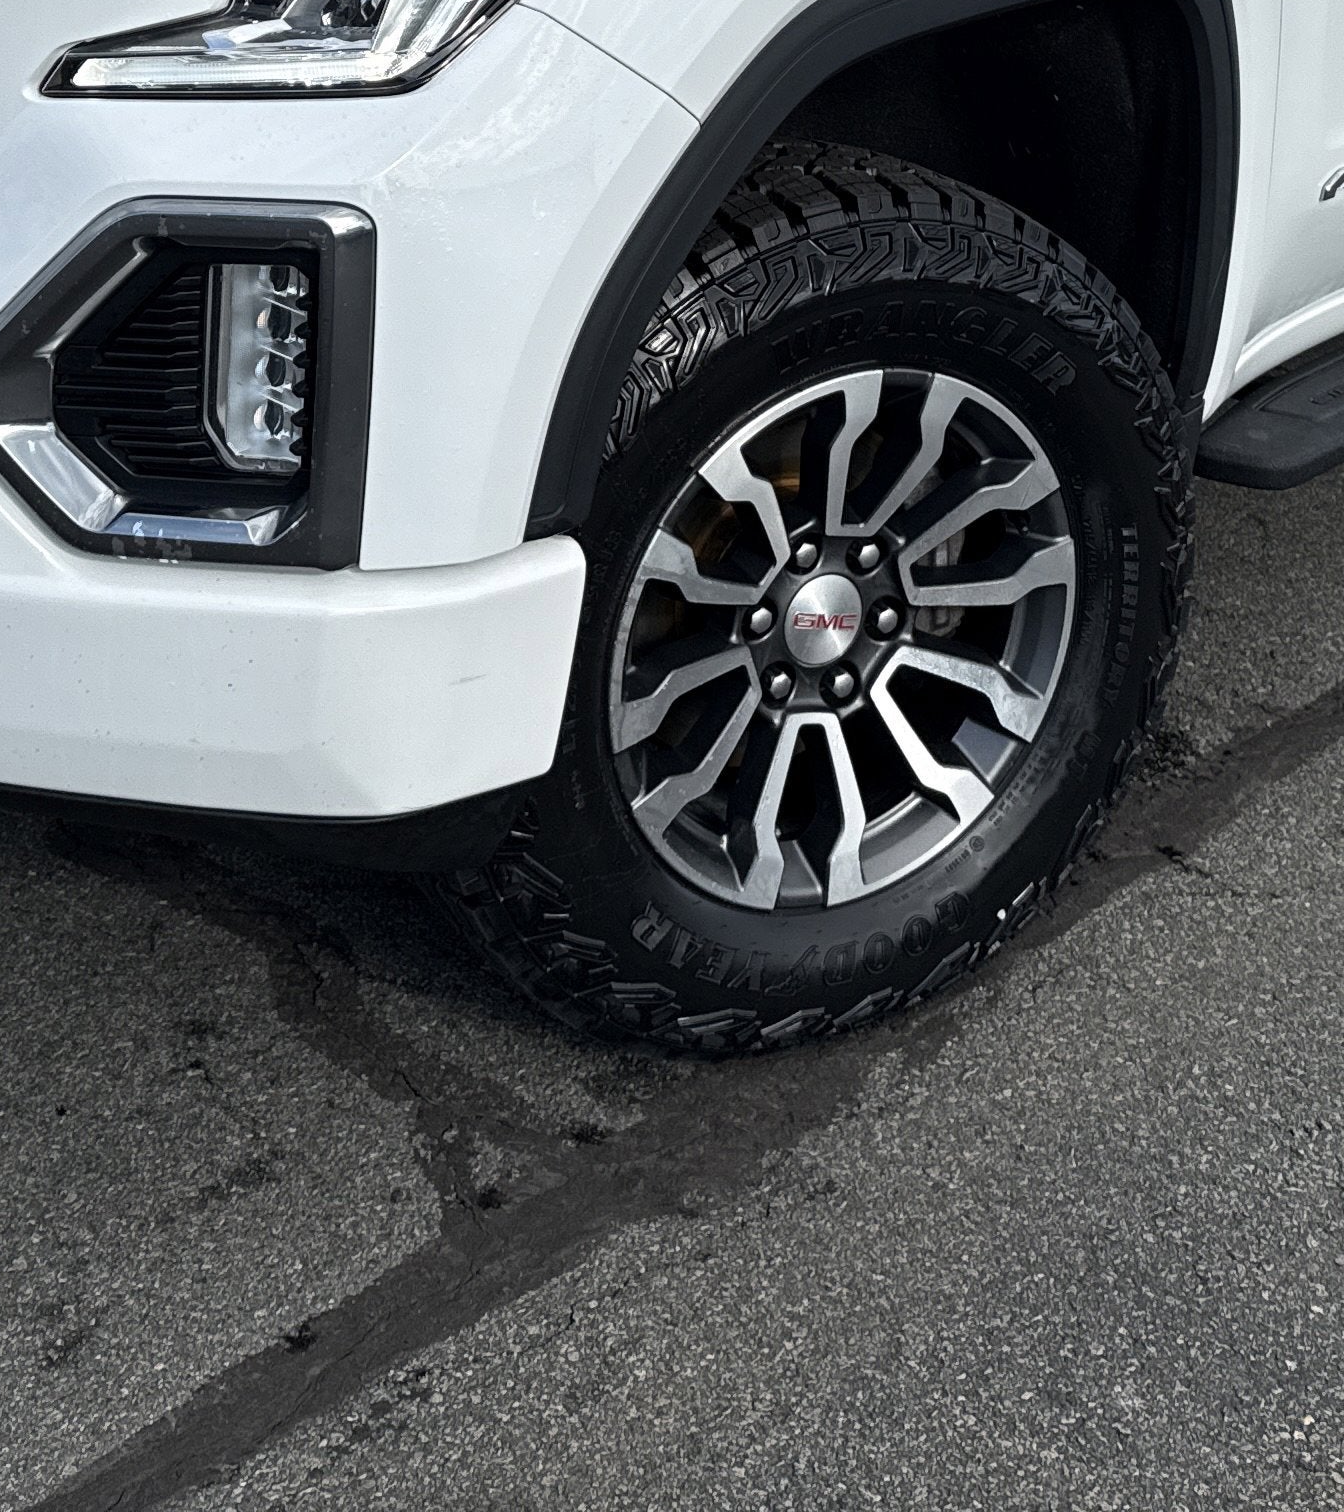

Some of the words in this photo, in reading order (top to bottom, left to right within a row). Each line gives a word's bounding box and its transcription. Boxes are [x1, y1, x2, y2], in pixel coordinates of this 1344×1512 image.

[770, 299, 1078, 397] WRANGLER
[792, 611, 858, 631] GMC
[1103, 522, 1140, 708] TERRITORY
[628, 899, 972, 999] GOODYEAR
